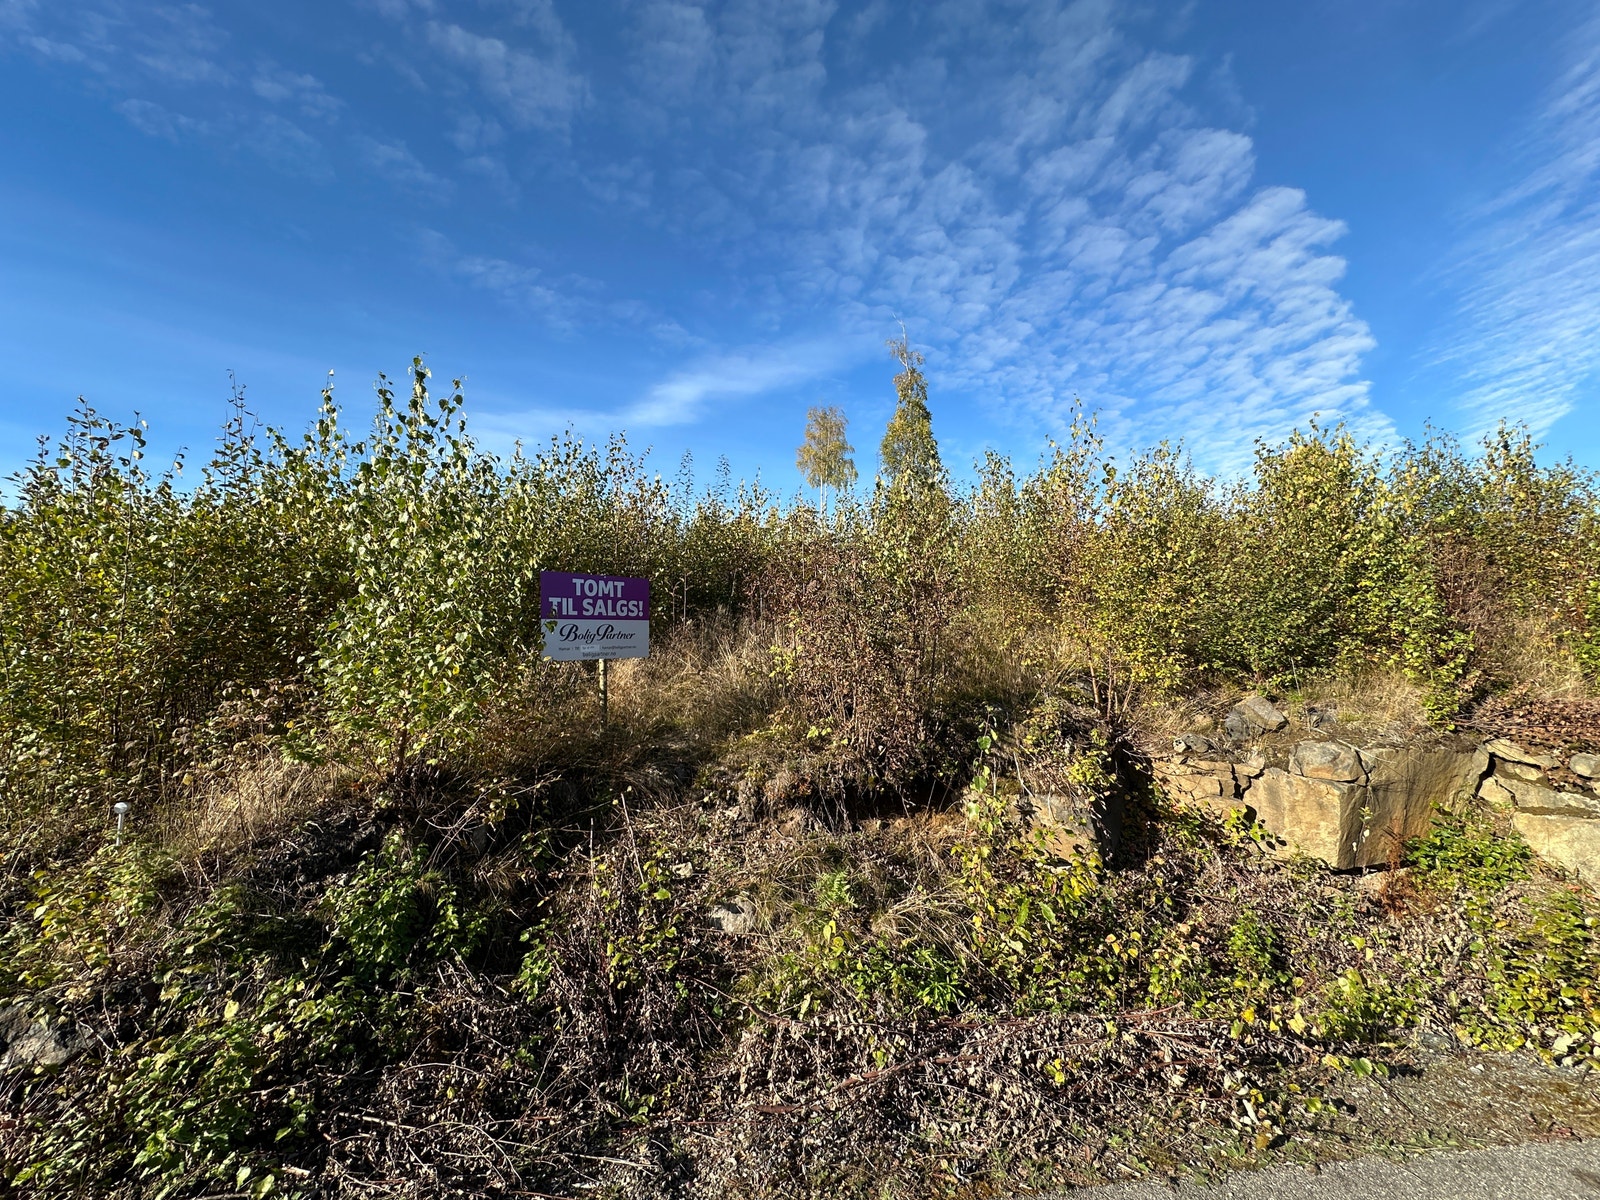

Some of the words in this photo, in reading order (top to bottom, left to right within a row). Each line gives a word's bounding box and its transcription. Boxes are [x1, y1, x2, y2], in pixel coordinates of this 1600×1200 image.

[572, 578, 625, 598] TOMT
[548, 597, 578, 616] TIL
[582, 598, 644, 617] SALGS!
